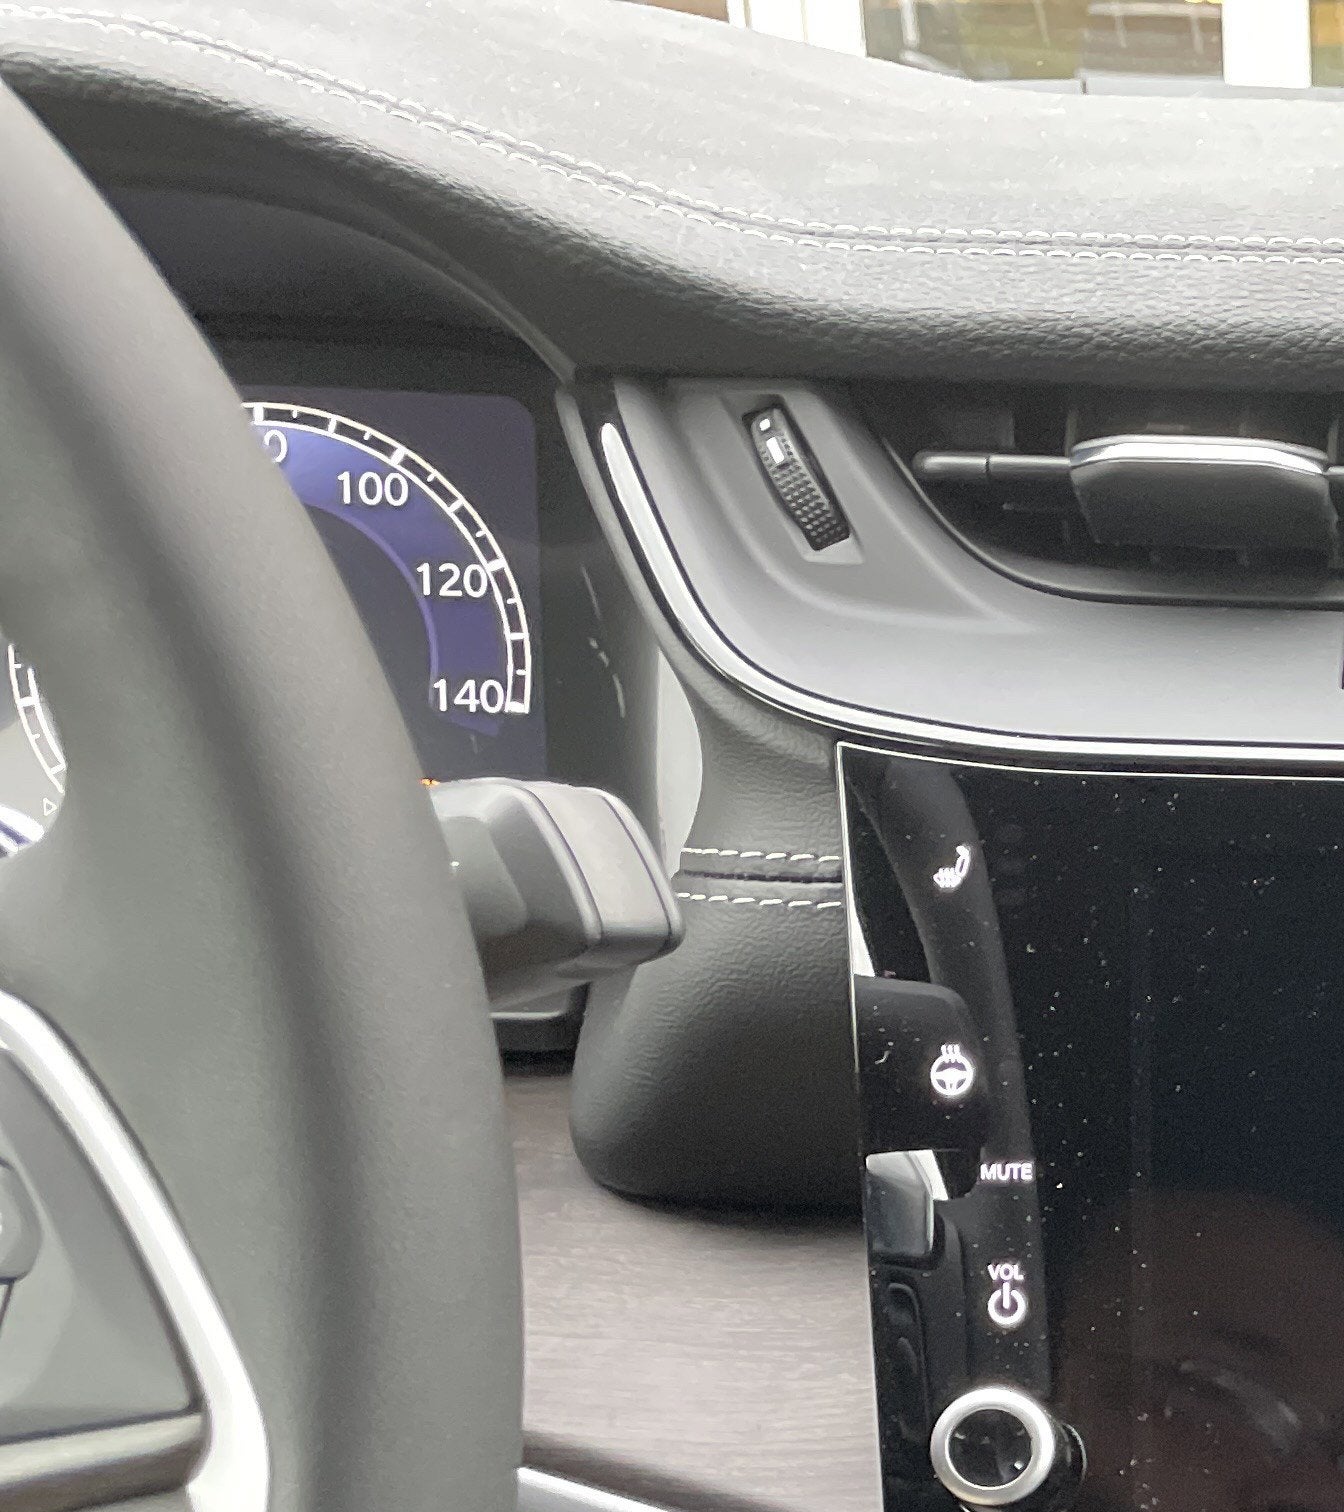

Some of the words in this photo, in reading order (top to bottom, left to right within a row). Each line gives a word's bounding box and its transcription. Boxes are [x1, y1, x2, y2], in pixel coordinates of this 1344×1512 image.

[337, 471, 409, 507] 100
[416, 562, 489, 598] 120
[433, 678, 505, 714] 140
[979, 1161, 1034, 1182] MUTE
[987, 1263, 1024, 1281] VOL
